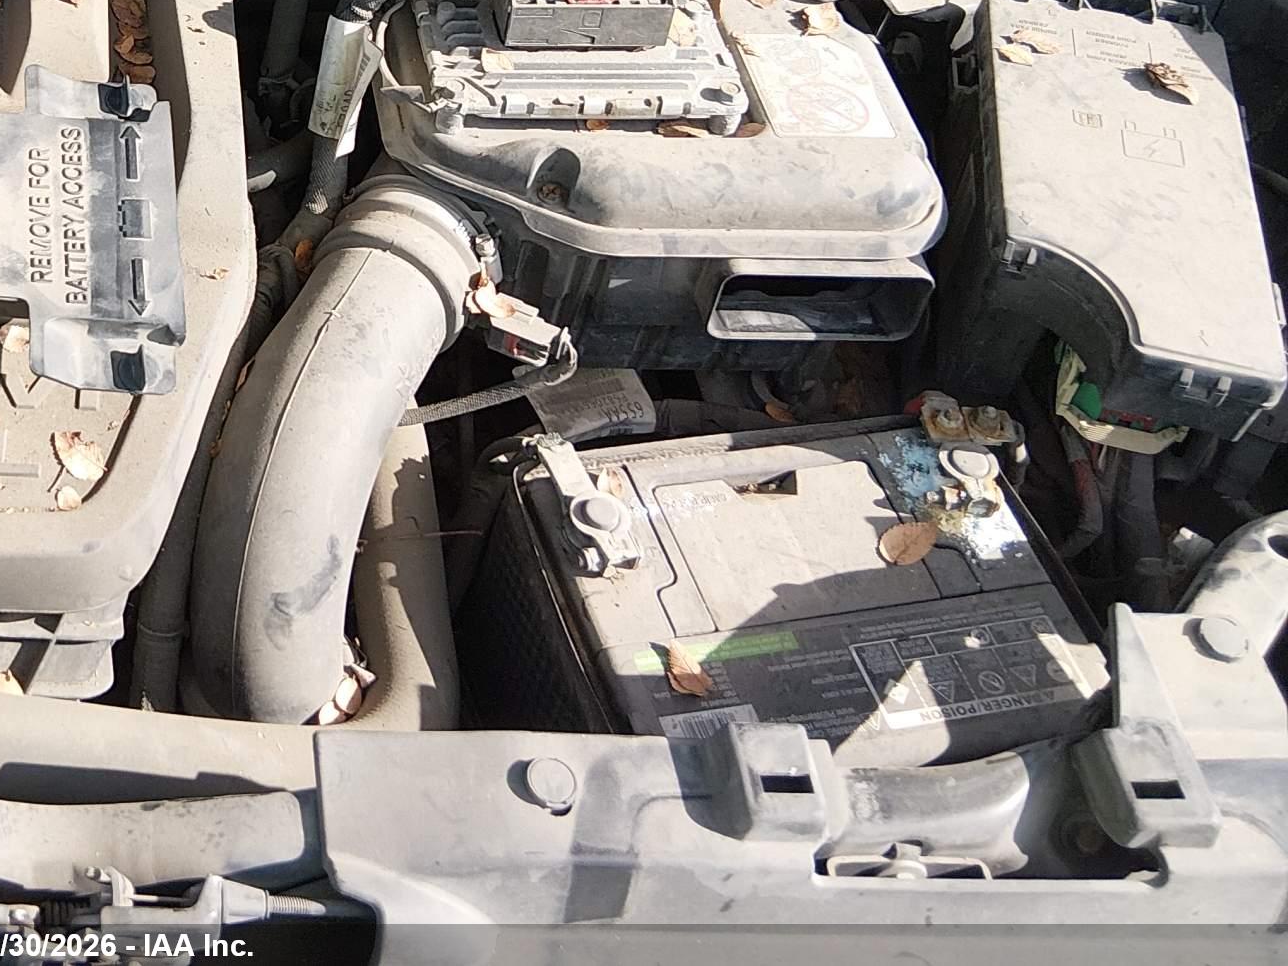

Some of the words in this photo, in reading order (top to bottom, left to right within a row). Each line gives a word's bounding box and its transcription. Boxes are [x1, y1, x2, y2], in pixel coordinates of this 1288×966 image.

[28, 147, 50, 189] FOR
[61, 127, 84, 210] ACCESS
[28, 196, 53, 283] REMOVE
[62, 214, 89, 305] BATTERY
